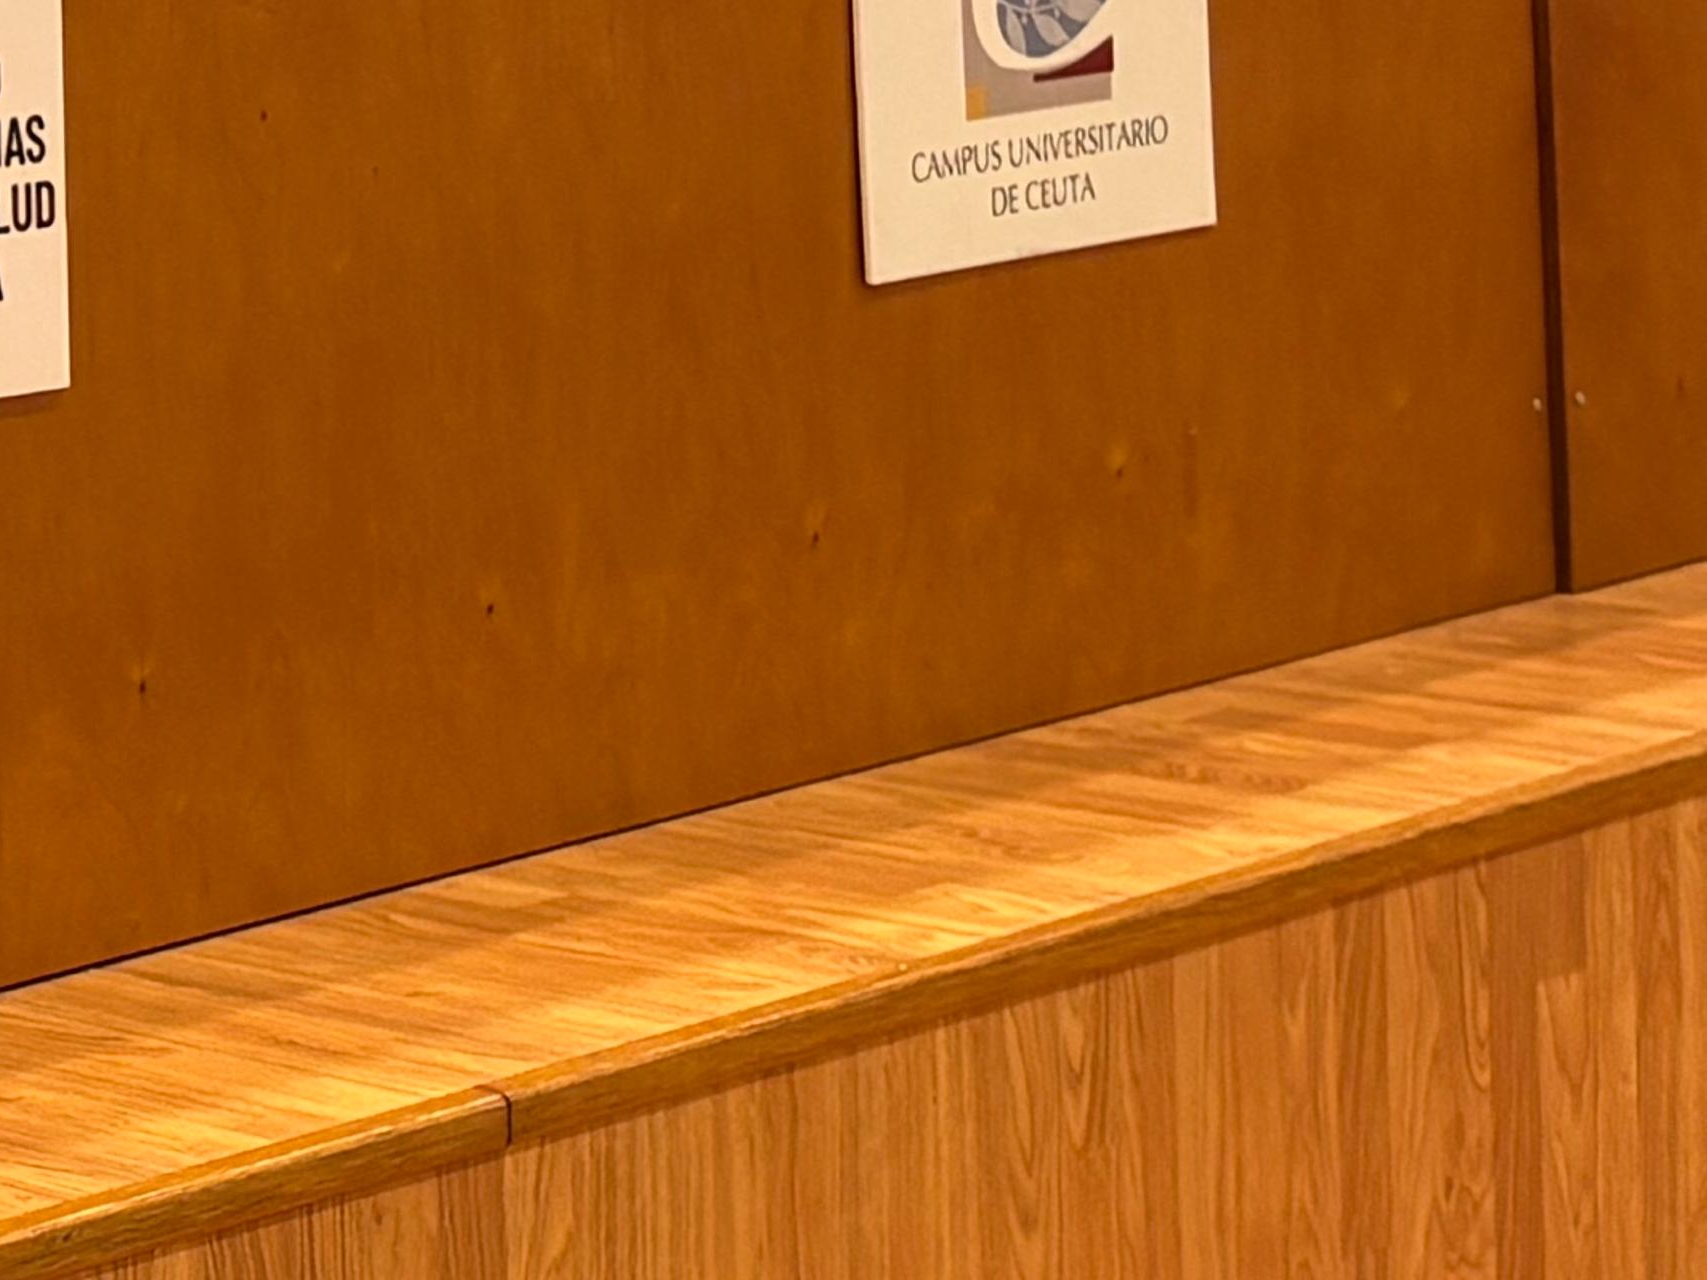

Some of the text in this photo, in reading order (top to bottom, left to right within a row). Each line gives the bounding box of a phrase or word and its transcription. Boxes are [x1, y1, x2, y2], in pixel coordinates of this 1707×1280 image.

[911, 114, 1169, 183] CAMPUS UNIVERSITARIO
[991, 172, 1096, 218] DE CEUTA
